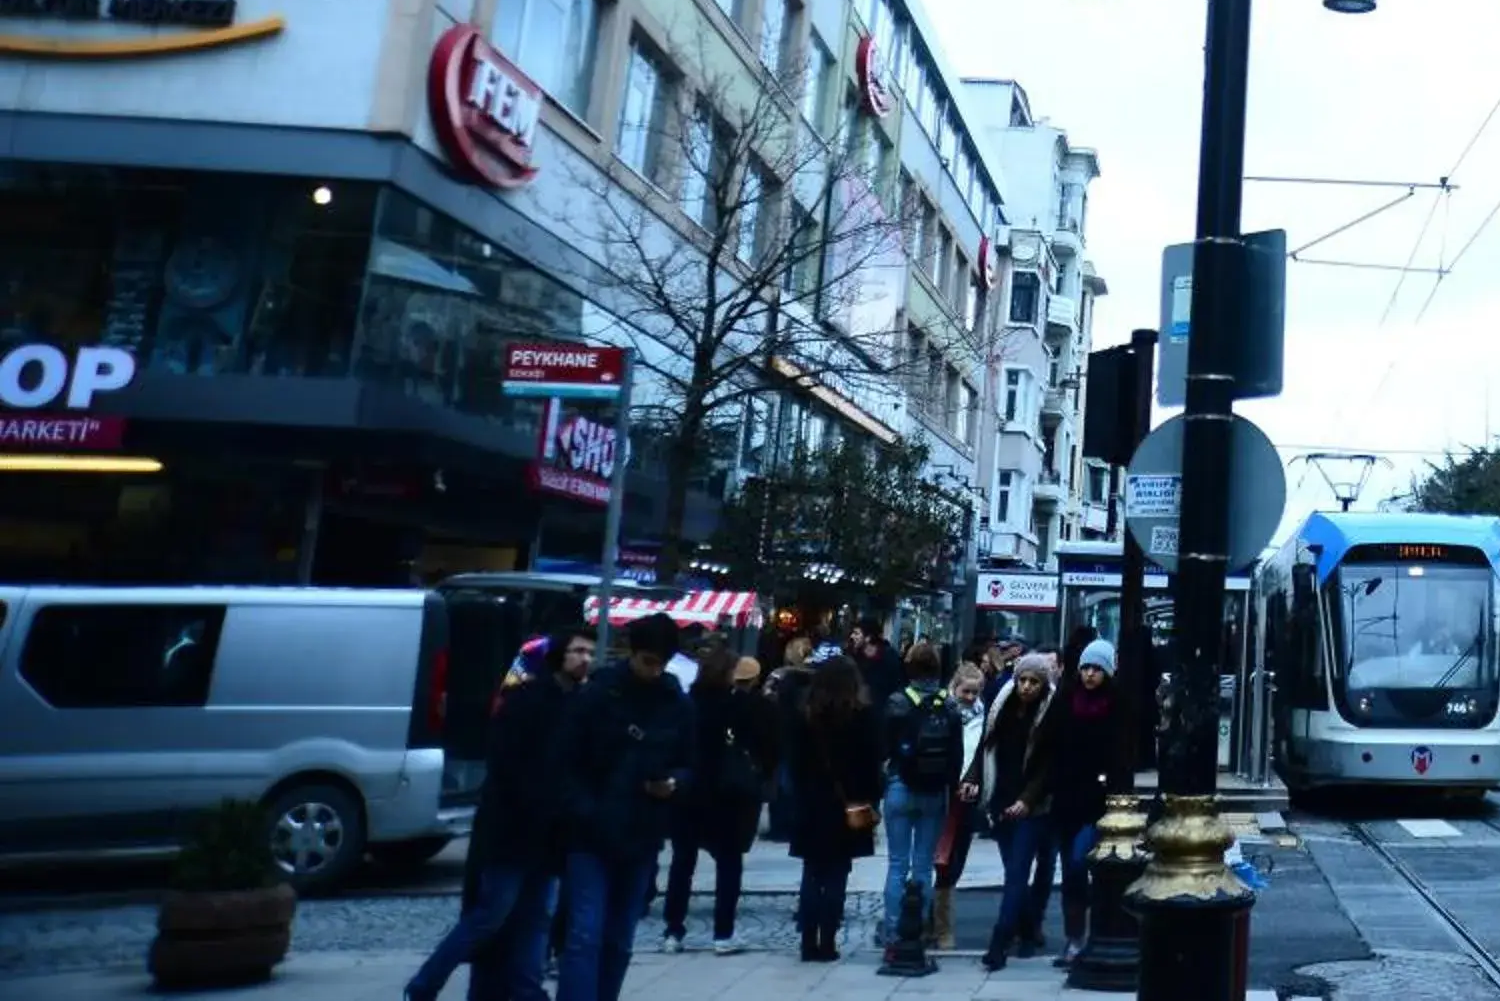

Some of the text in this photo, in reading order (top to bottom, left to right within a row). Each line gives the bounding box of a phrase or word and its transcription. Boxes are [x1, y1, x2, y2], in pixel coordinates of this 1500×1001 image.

[470, 59, 542, 147] FEM
[0, 344, 135, 408] OP
[510, 349, 599, 368] PEYKHANE
[0, 418, 100, 443] ARKETİ"
